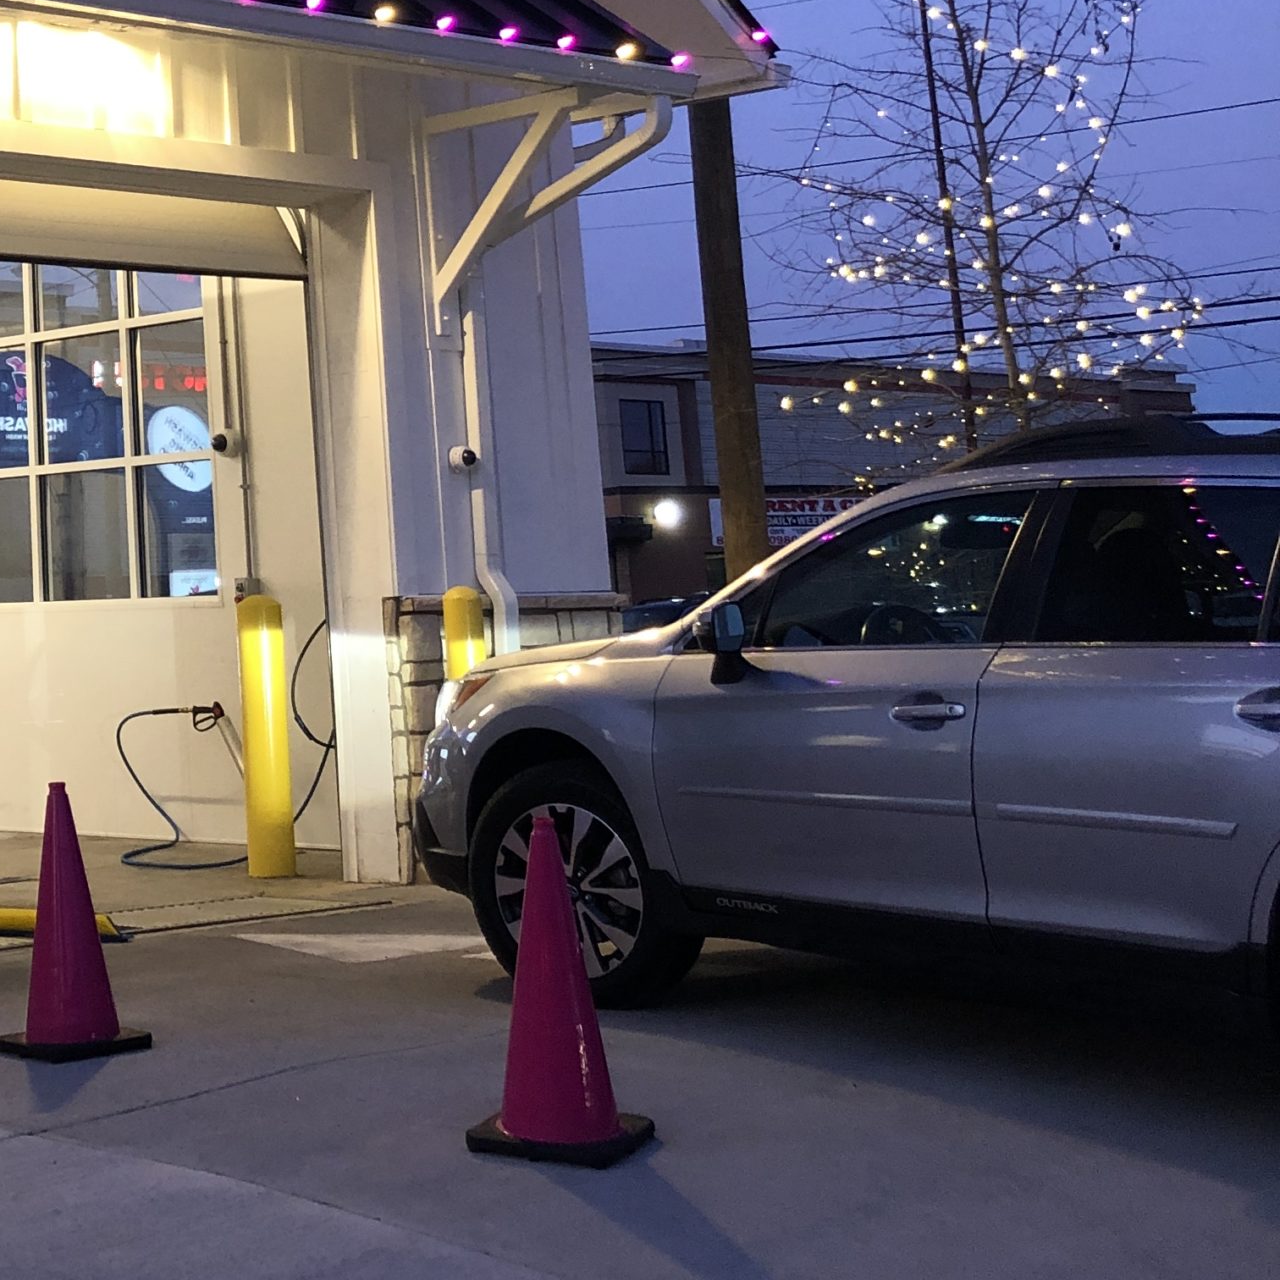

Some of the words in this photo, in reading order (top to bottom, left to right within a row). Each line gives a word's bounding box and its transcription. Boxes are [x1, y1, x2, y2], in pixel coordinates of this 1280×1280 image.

[766, 499, 819, 512] RENT
[823, 500, 837, 512] A
[716, 897, 779, 914] OUTBACK
